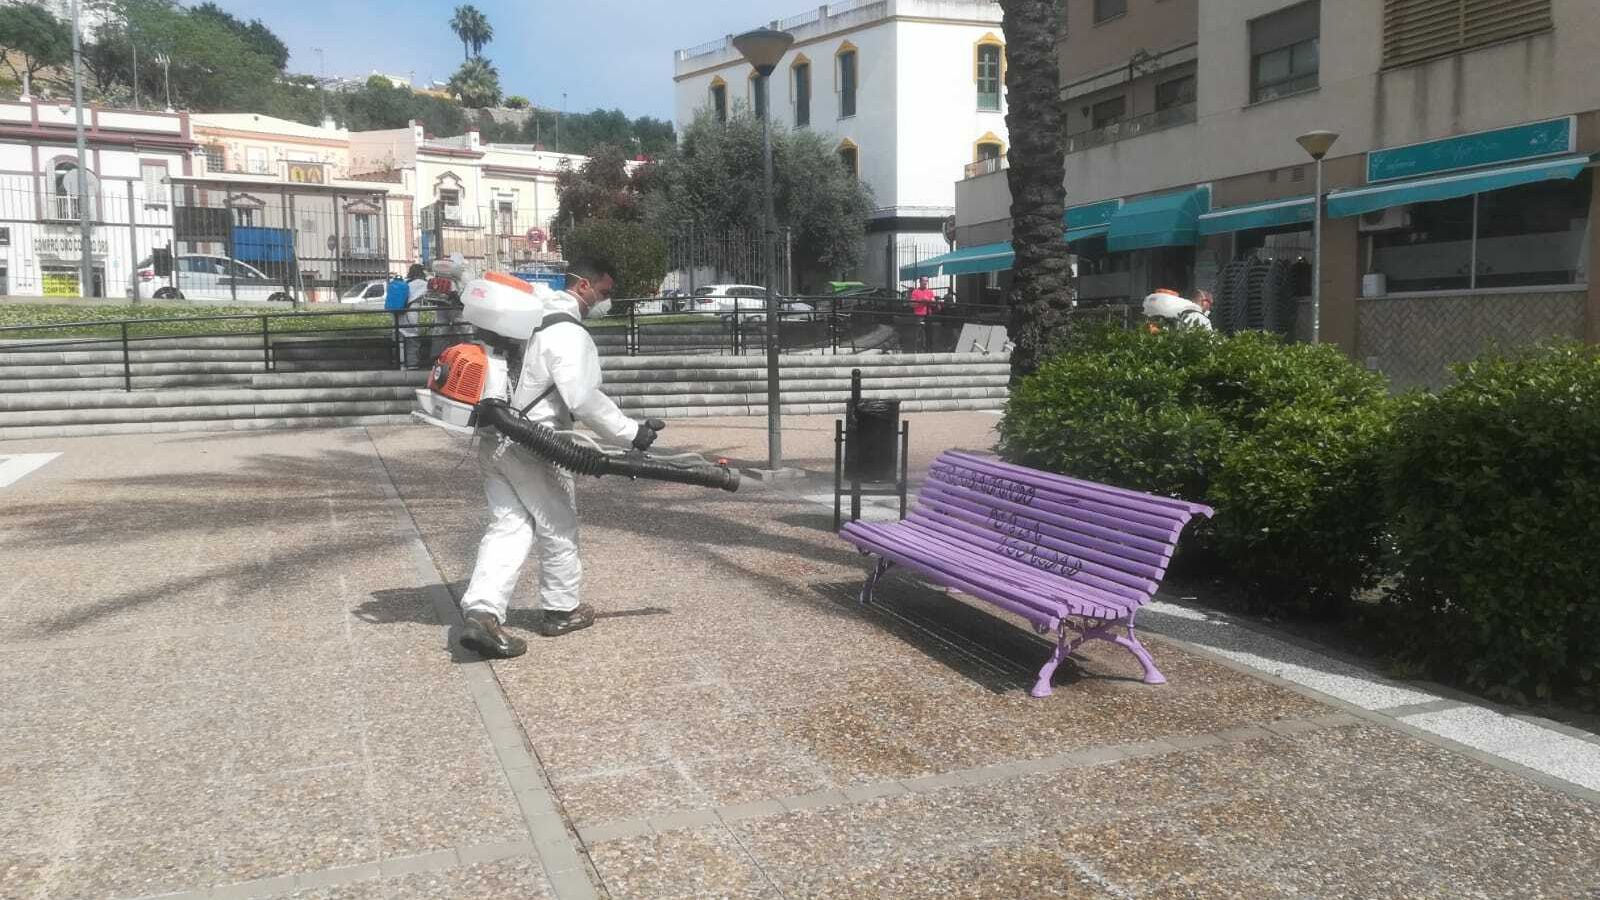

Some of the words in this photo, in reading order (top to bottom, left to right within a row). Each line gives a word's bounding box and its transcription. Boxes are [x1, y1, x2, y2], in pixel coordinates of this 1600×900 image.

[34, 238, 59, 252] COMPRO
[60, 238, 73, 252] ORO
[73, 239, 97, 252] COO
